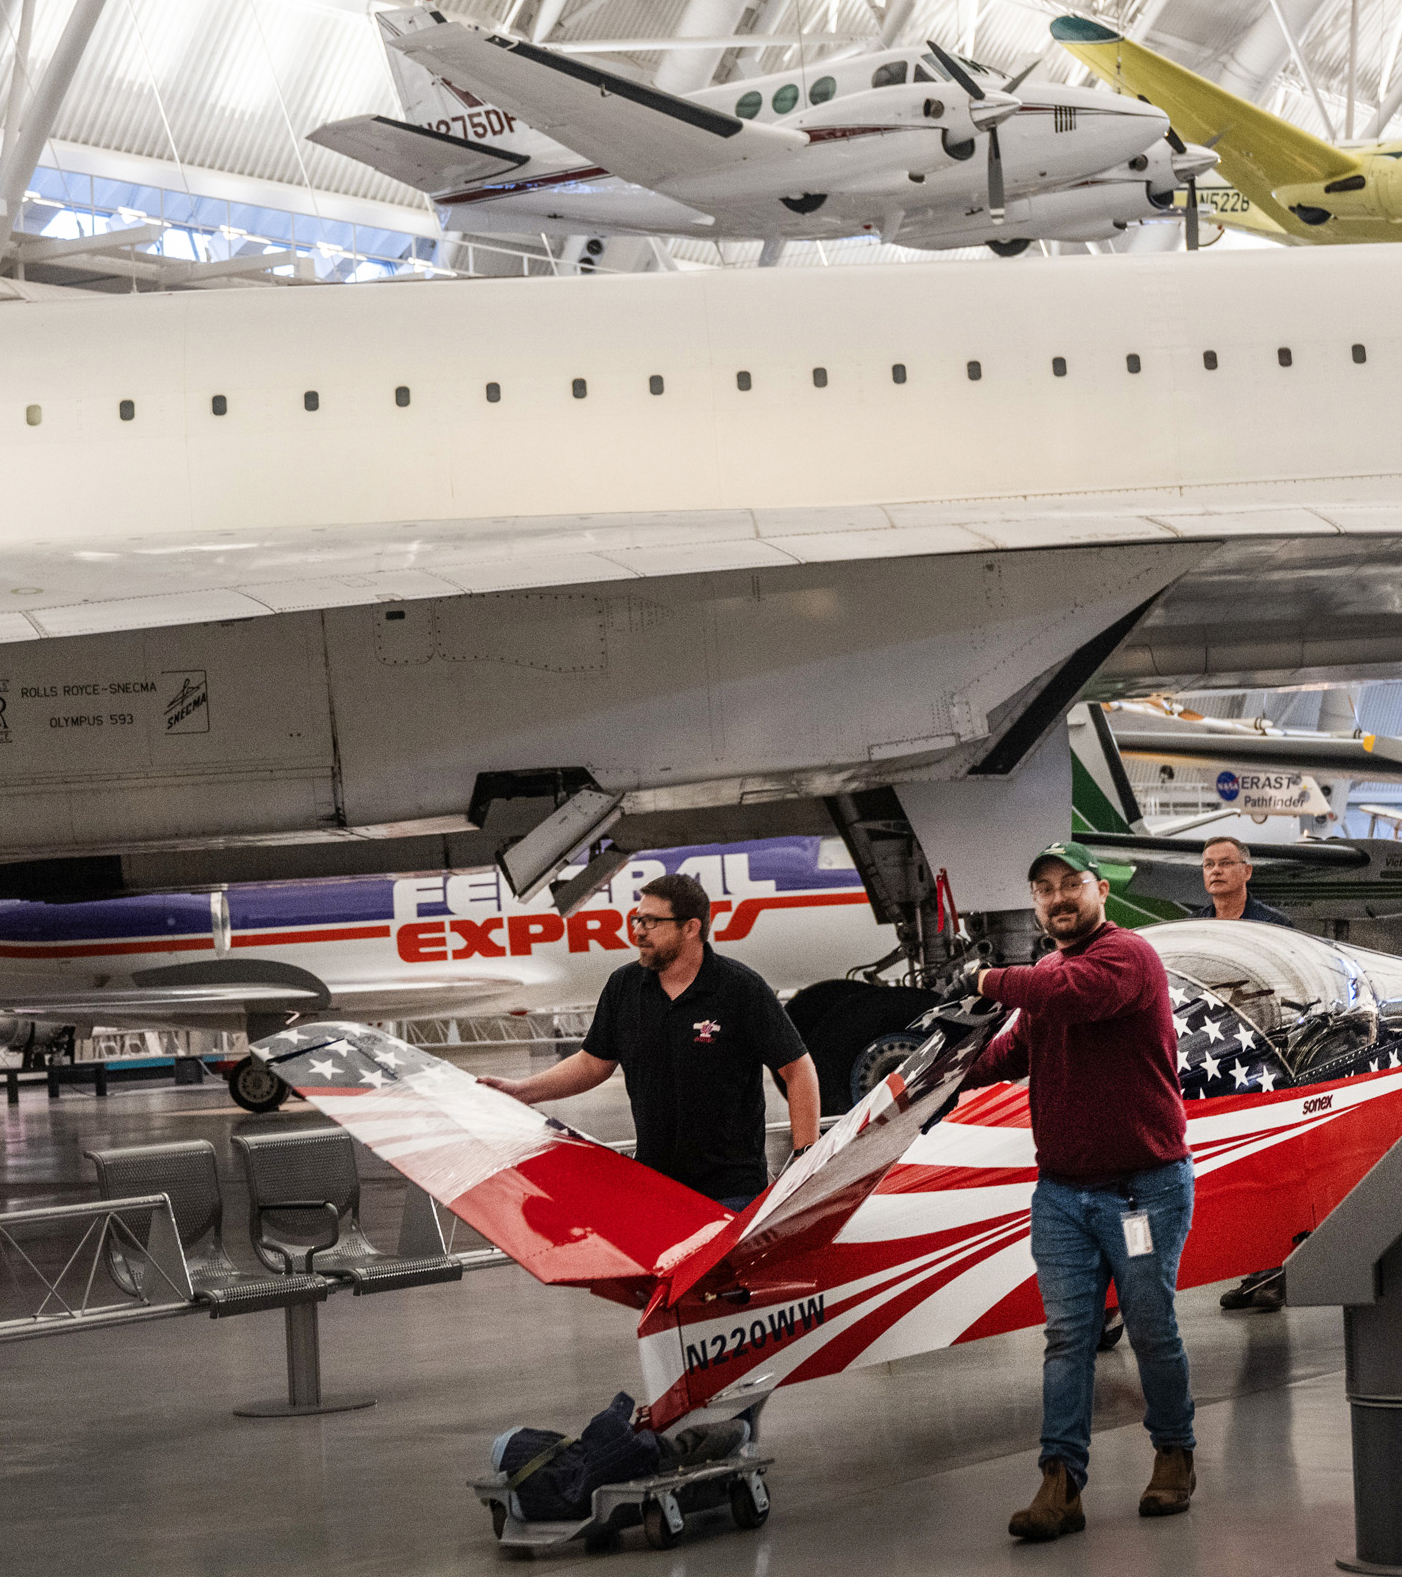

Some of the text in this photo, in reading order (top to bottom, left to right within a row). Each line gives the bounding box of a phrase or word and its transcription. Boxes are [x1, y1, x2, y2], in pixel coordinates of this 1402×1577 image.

[21, 682, 157, 698] ROLLS ROYCE-SNECMA
[167, 692, 208, 730] SNECMA
[50, 713, 134, 728] OLYMPUS 593
[1241, 775, 1293, 790] ERAST
[1244, 795, 1305, 808] Pathfinder
[393, 852, 777, 921] FERAL
[1302, 1094, 1333, 1115] sonex
[686, 1293, 826, 1375] N220WW
